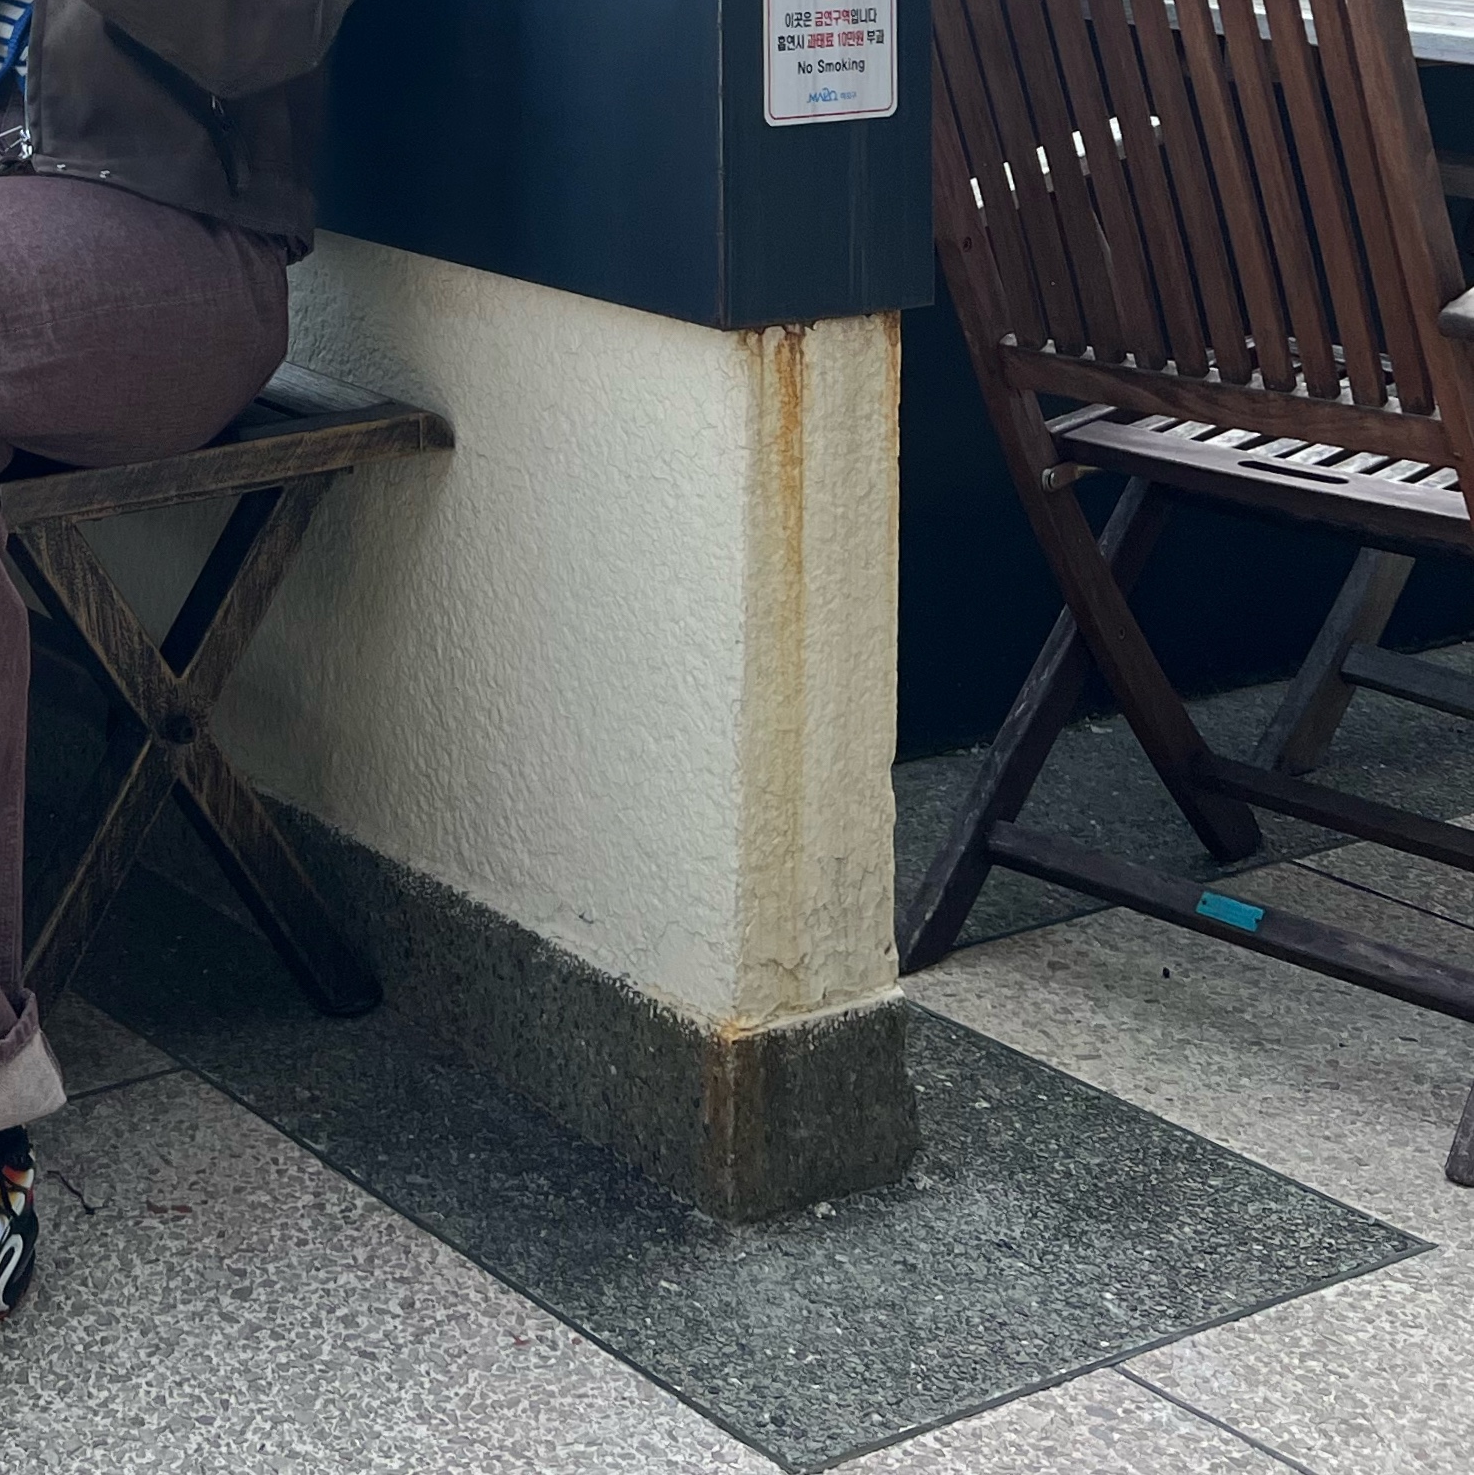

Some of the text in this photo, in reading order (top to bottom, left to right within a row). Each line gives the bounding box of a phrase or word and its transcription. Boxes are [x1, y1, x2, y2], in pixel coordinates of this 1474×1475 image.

[785, 8, 877, 28] 이곳은 금연구역입니다
[777, 29, 885, 51] 흡연시 과태료 10만원 부과
[797, 58, 866, 75] No Smoking
